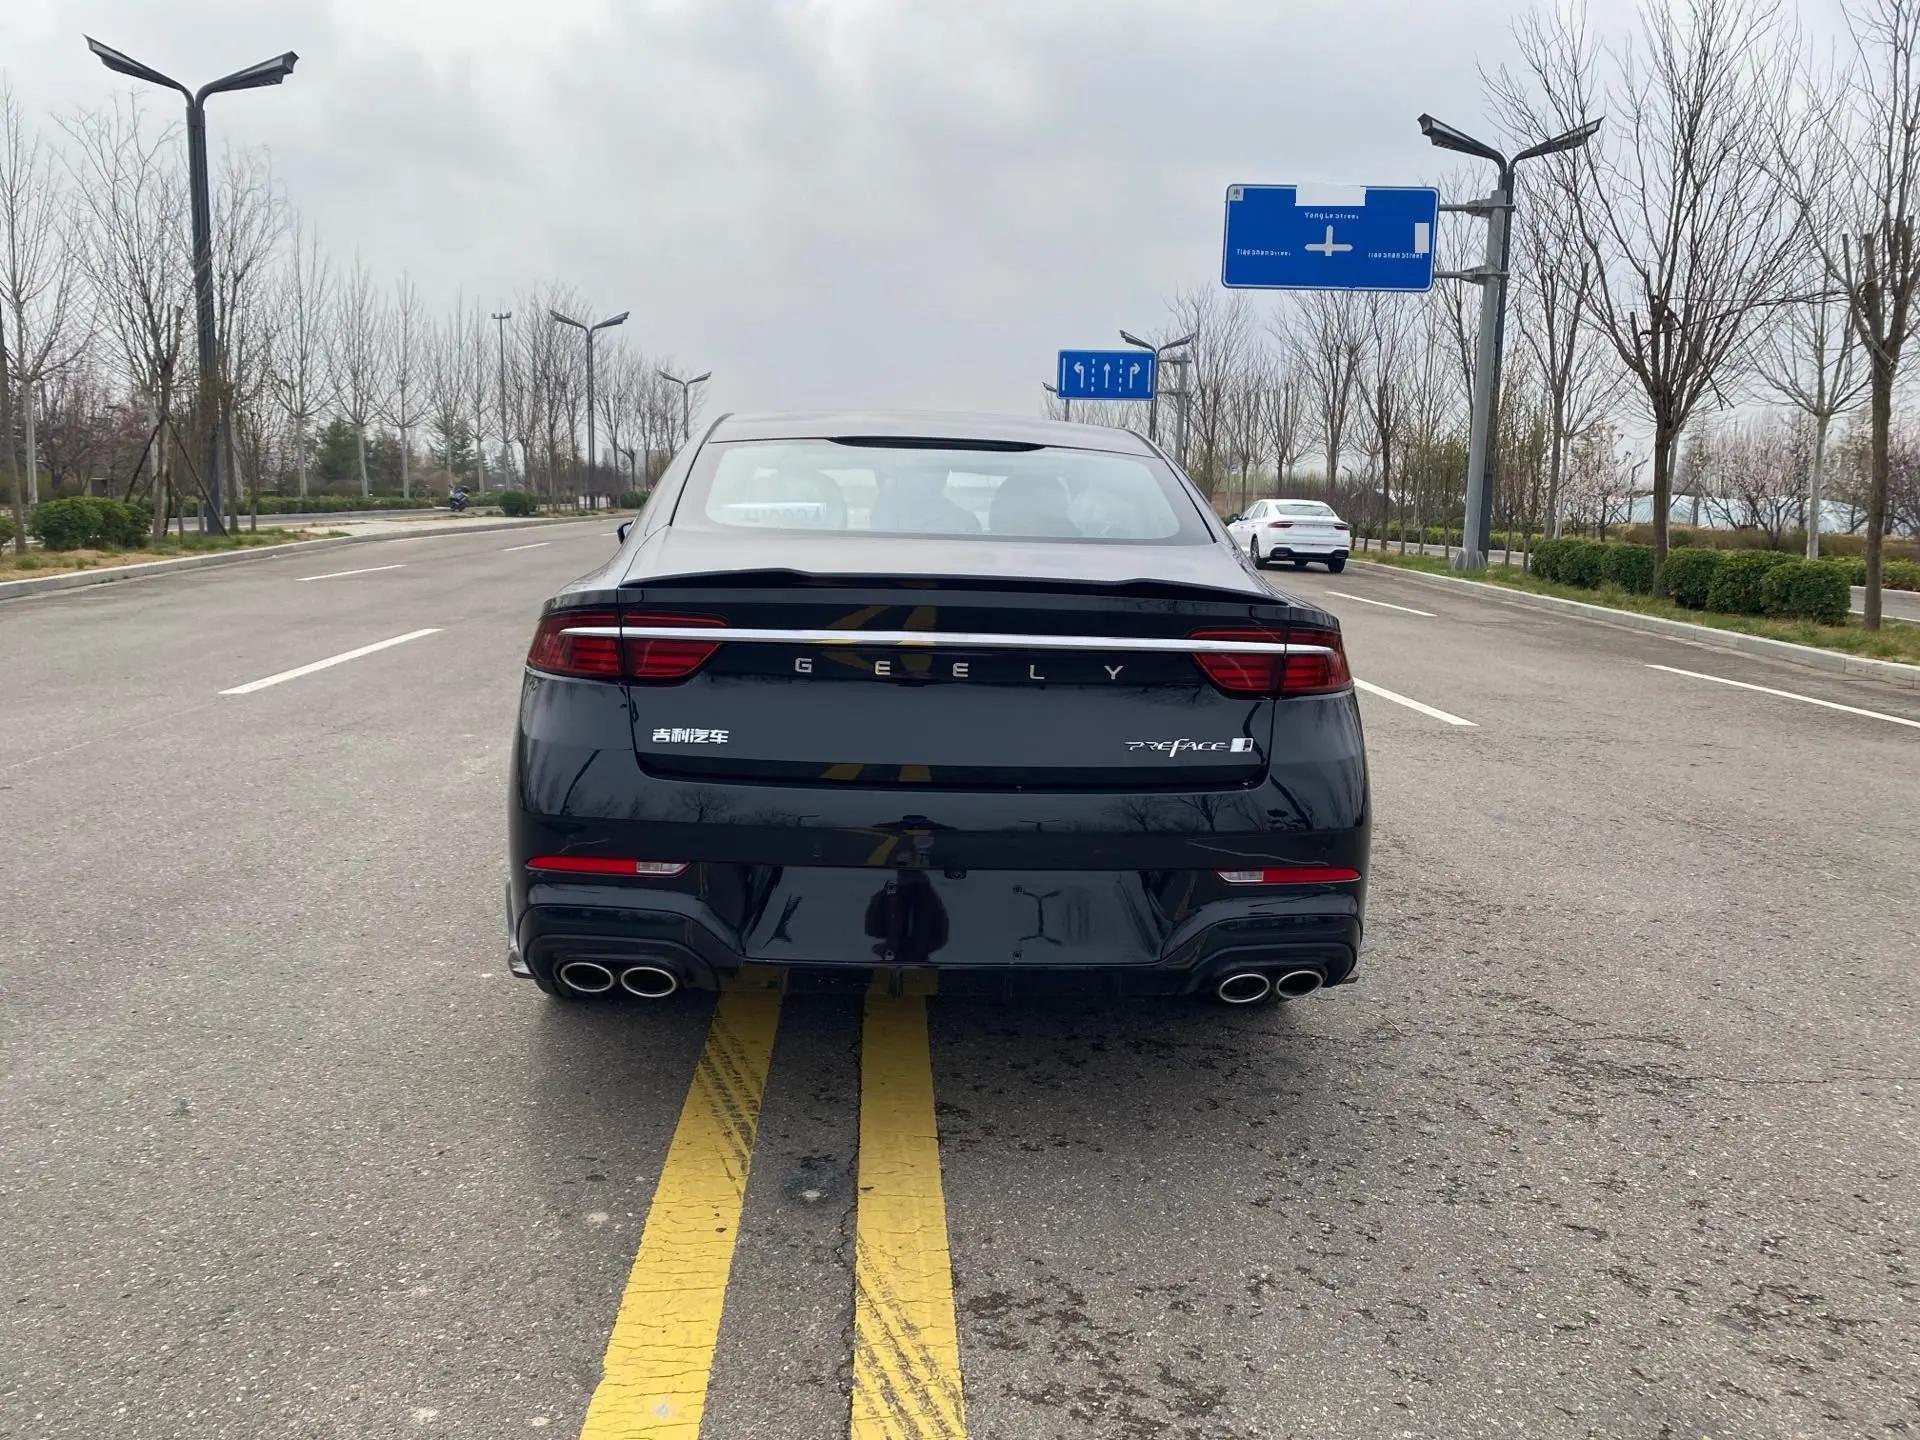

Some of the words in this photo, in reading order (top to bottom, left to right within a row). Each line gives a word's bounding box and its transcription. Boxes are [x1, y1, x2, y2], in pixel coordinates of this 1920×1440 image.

[795, 657, 1123, 680] GEELY
[652, 728, 729, 744] 吉利汽车
